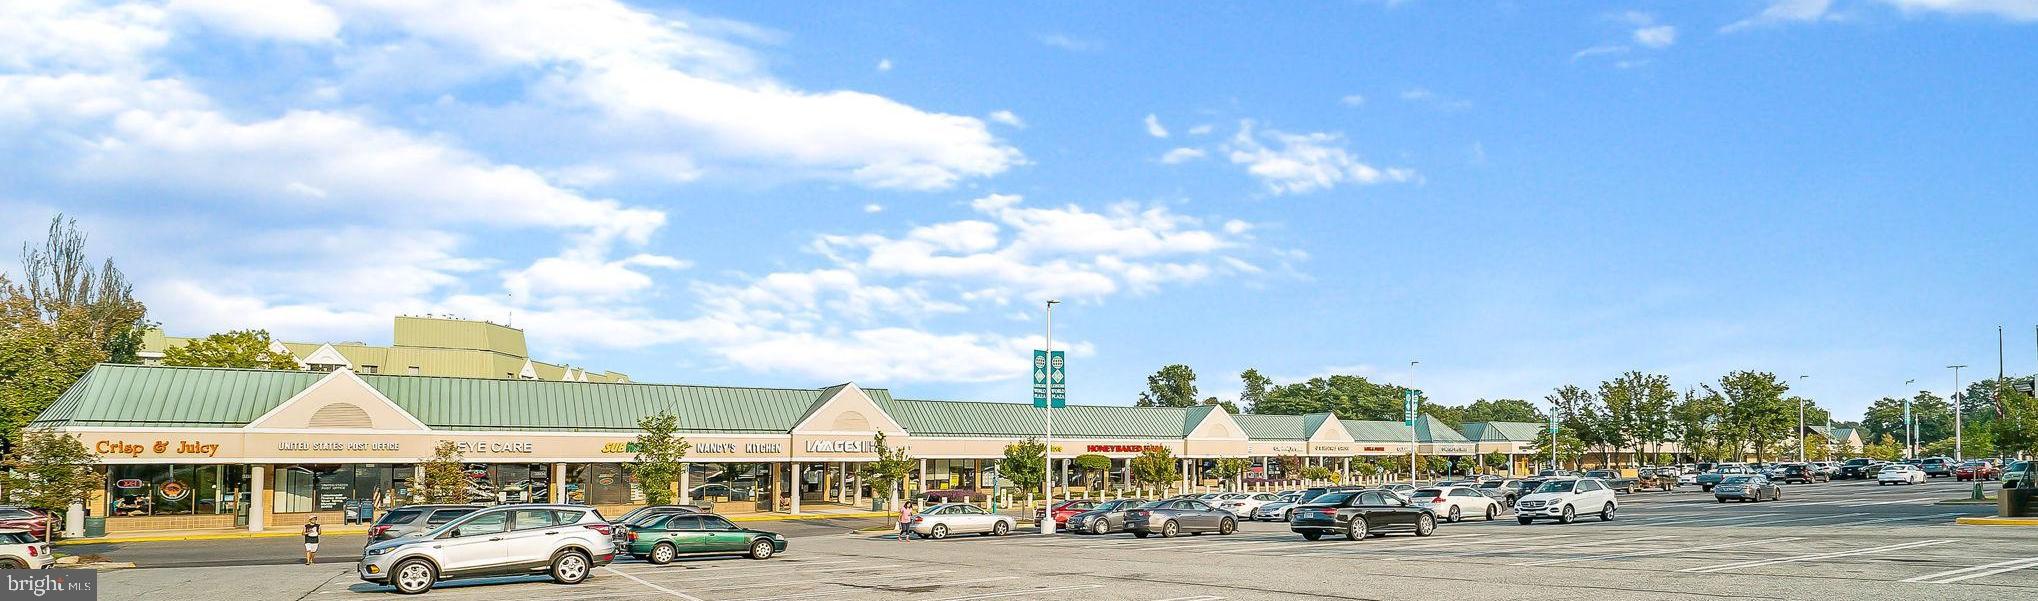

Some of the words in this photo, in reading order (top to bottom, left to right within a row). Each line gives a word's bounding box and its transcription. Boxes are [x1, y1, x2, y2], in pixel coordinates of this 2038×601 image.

[96, 440, 144, 457] Crisp
[152, 440, 169, 453] &
[176, 440, 219, 457] Juicy
[278, 442, 309, 450] UNITED
[313, 442, 343, 450] STATES
[347, 442, 369, 450] POST
[372, 442, 400, 450] OFFICE
[457, 441, 486, 453] EYE
[491, 441, 532, 453] CARE
[601, 442, 644, 453] SUBW
[696, 443, 736, 453] NANCY'S
[745, 443, 781, 453] KITCHEN
